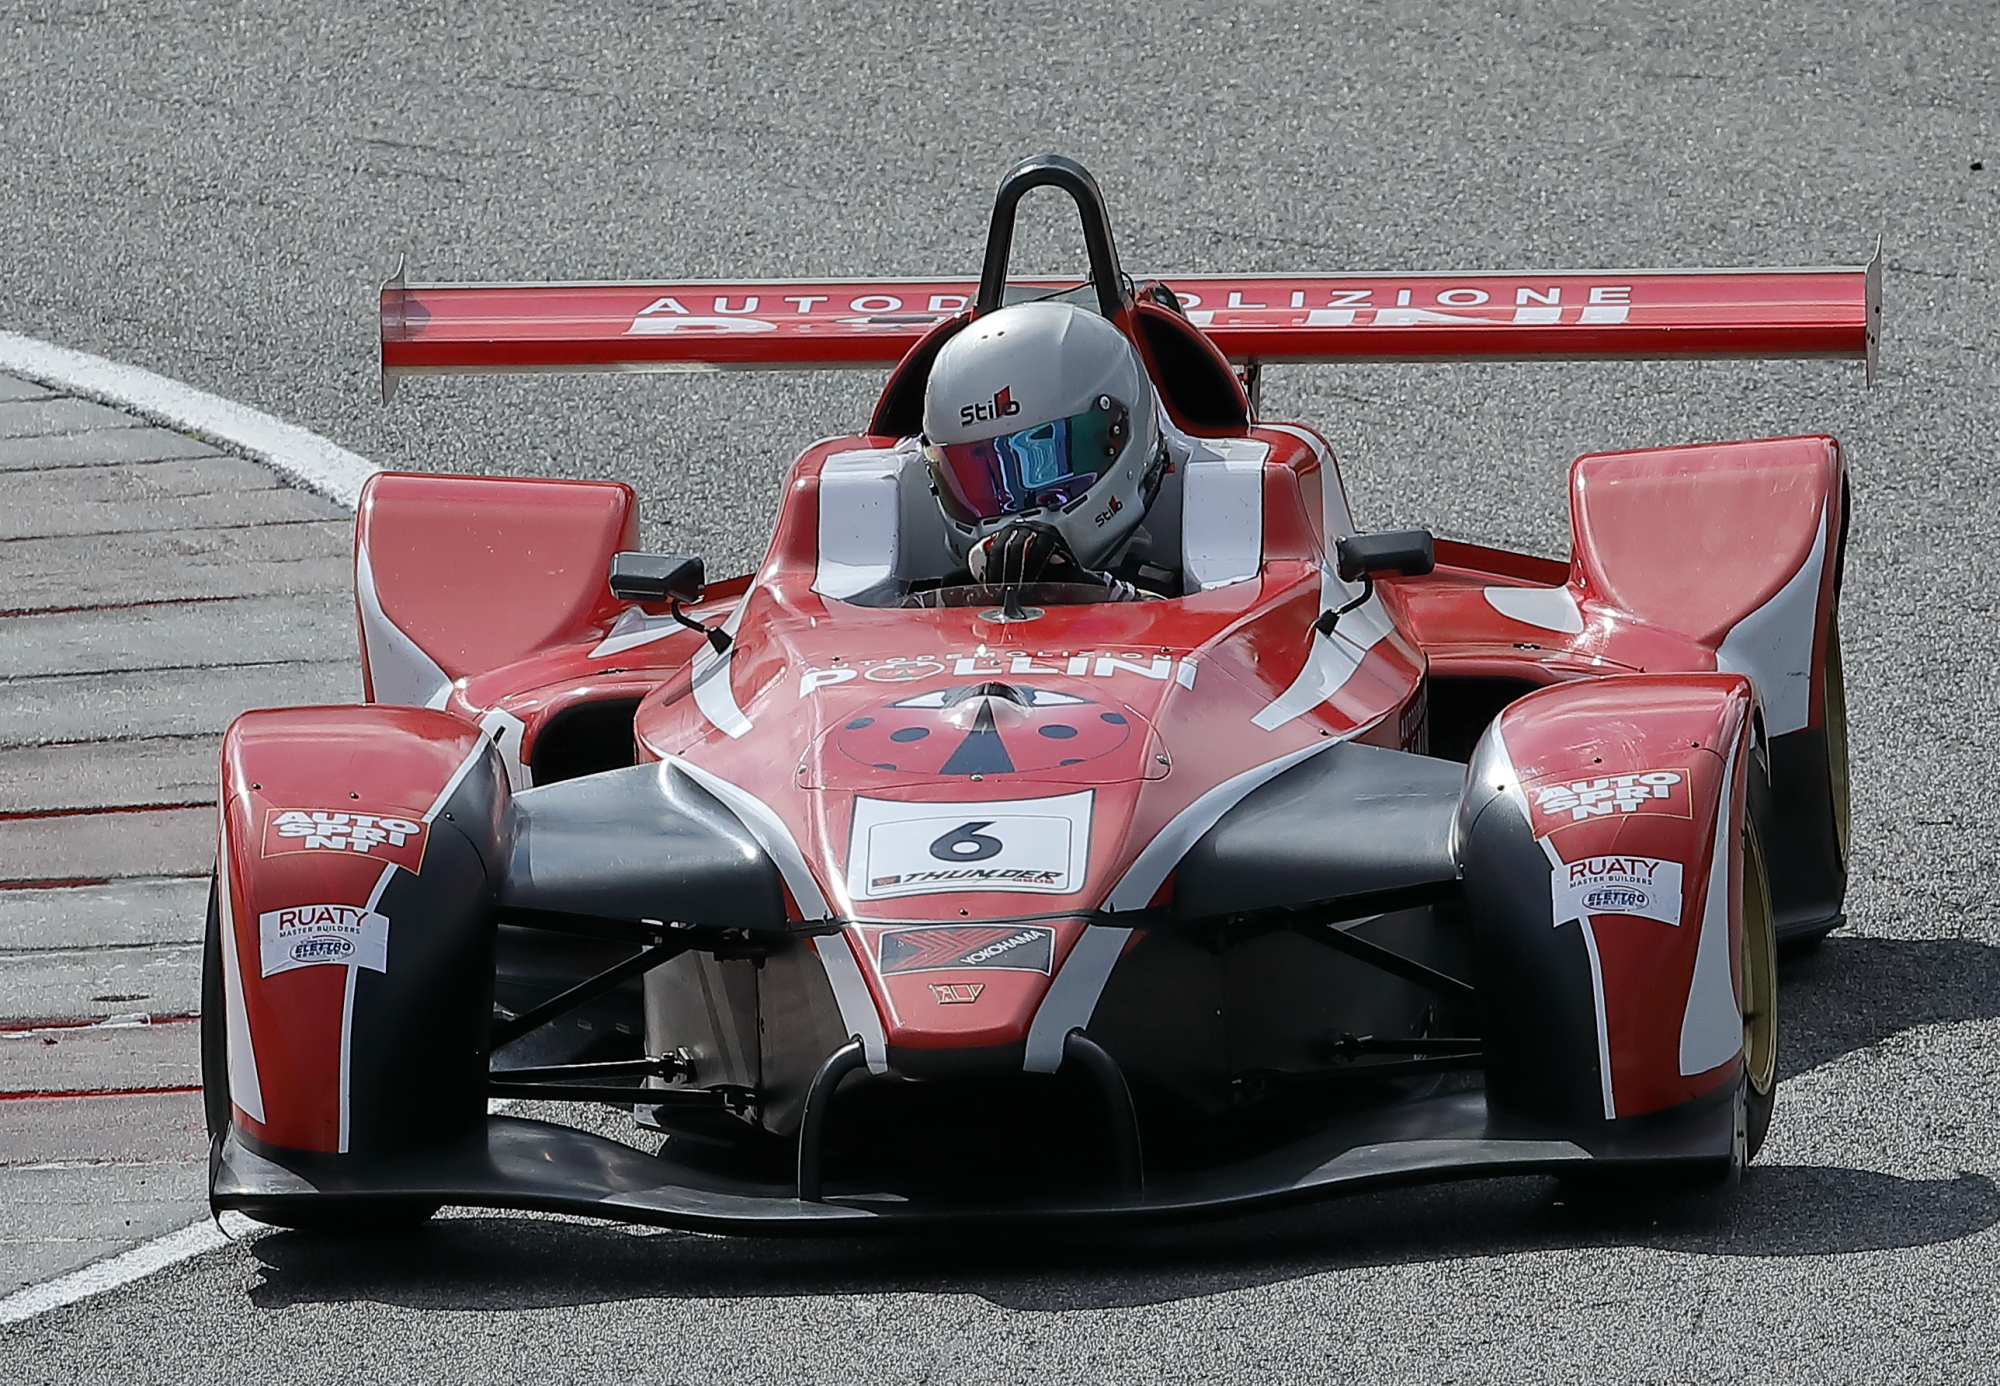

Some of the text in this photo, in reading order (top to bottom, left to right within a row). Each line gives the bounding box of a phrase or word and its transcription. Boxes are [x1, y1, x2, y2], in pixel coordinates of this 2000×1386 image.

[1534, 771, 1682, 806] AUTO
[271, 810, 422, 835] AUTO
[929, 820, 1004, 863] 6
[903, 868, 1065, 884] THUNDER
[1569, 857, 1660, 882] RUATY
[1569, 875, 1653, 889] MASTER BUILDERS
[1588, 892, 1646, 903] ELETTRO
[279, 906, 369, 930] RUATY
[279, 924, 361, 939] MASTER BUILDERS
[295, 942, 351, 954] ELETTRO
[959, 929, 1047, 965] YOKOHAMA
